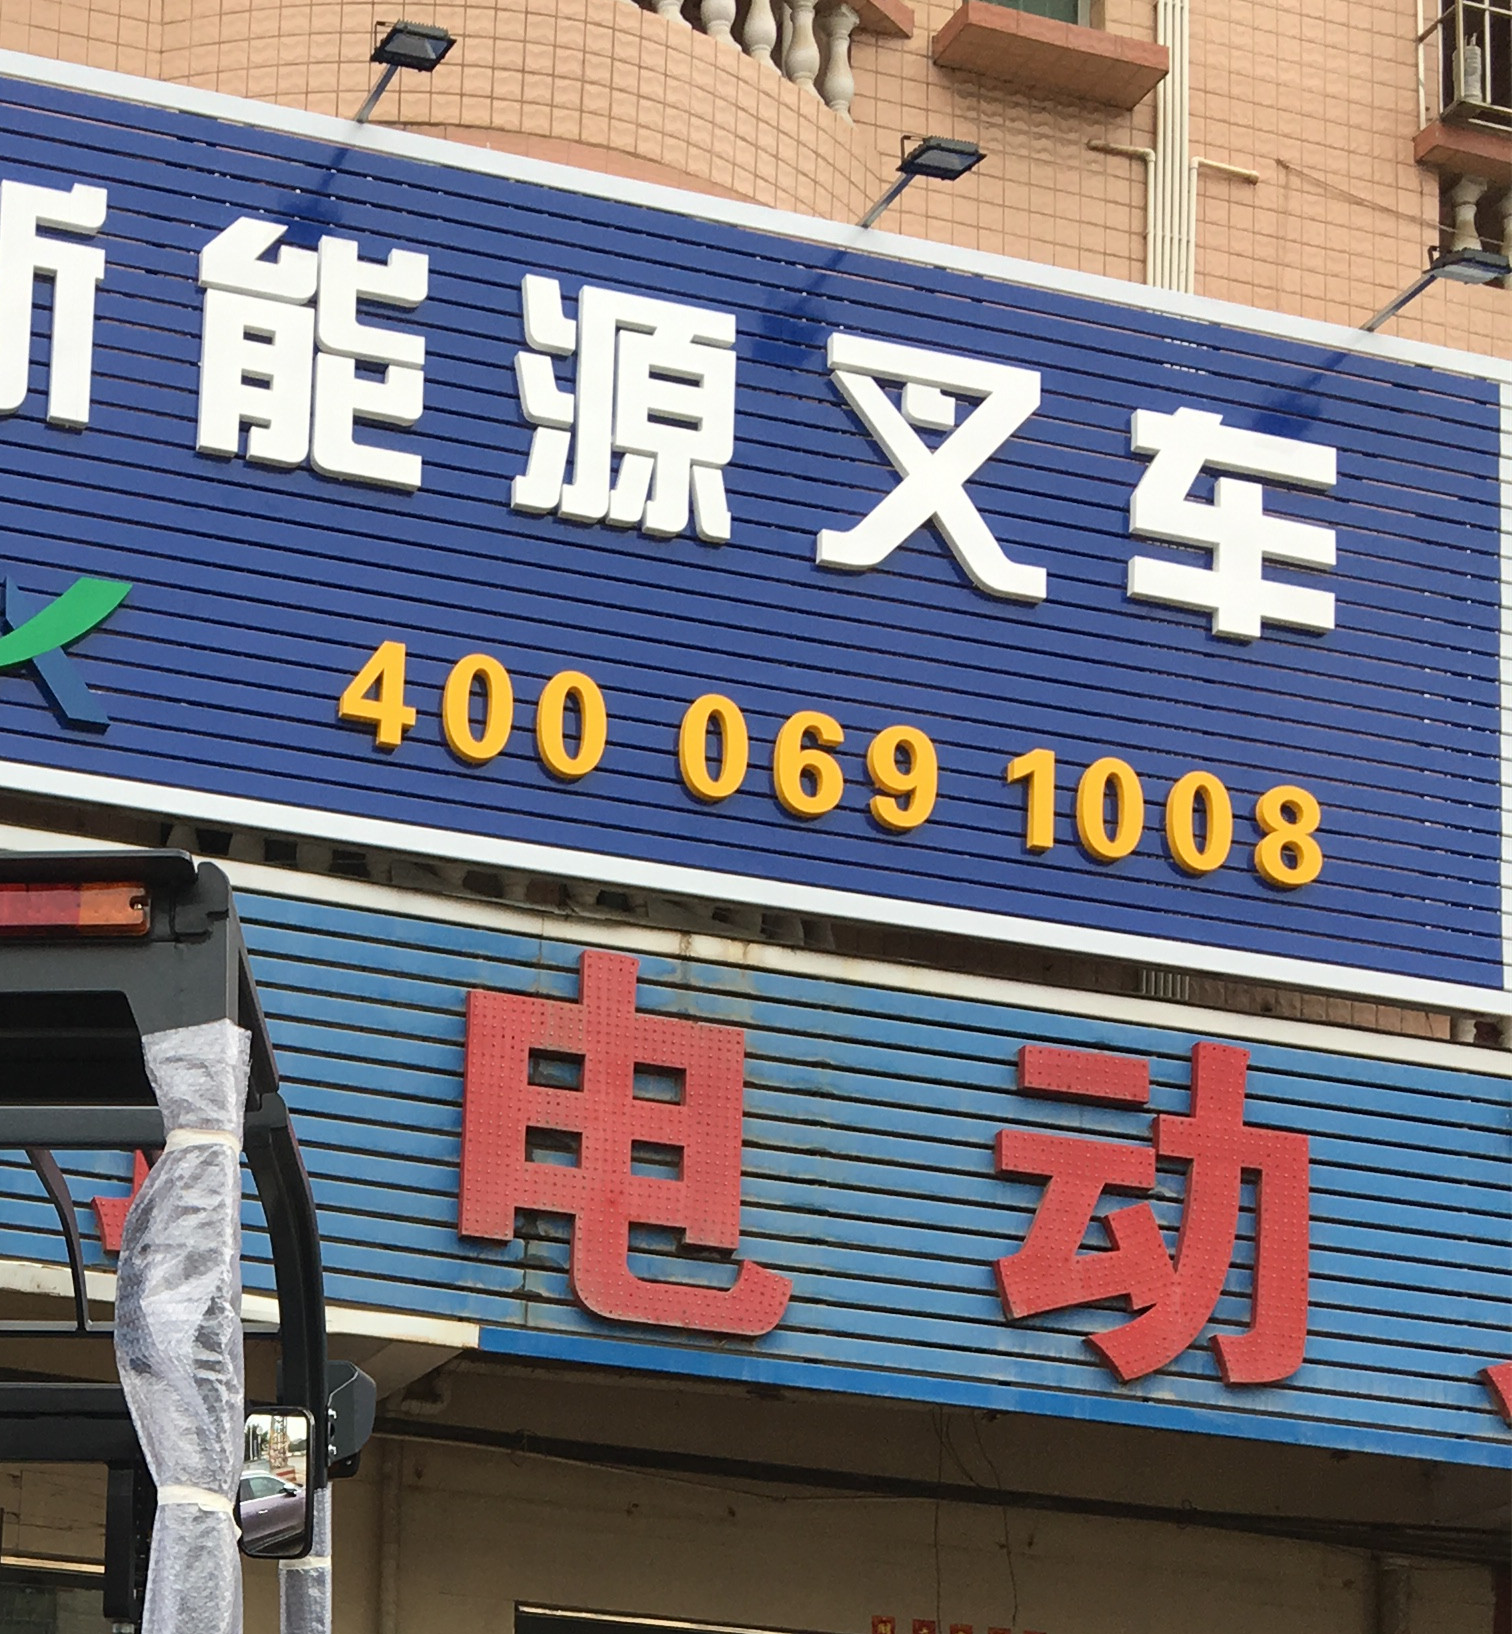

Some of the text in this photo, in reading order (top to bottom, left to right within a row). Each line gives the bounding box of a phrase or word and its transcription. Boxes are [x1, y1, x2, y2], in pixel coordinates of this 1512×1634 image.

[339, 640, 1325, 890] 400 069 1008
